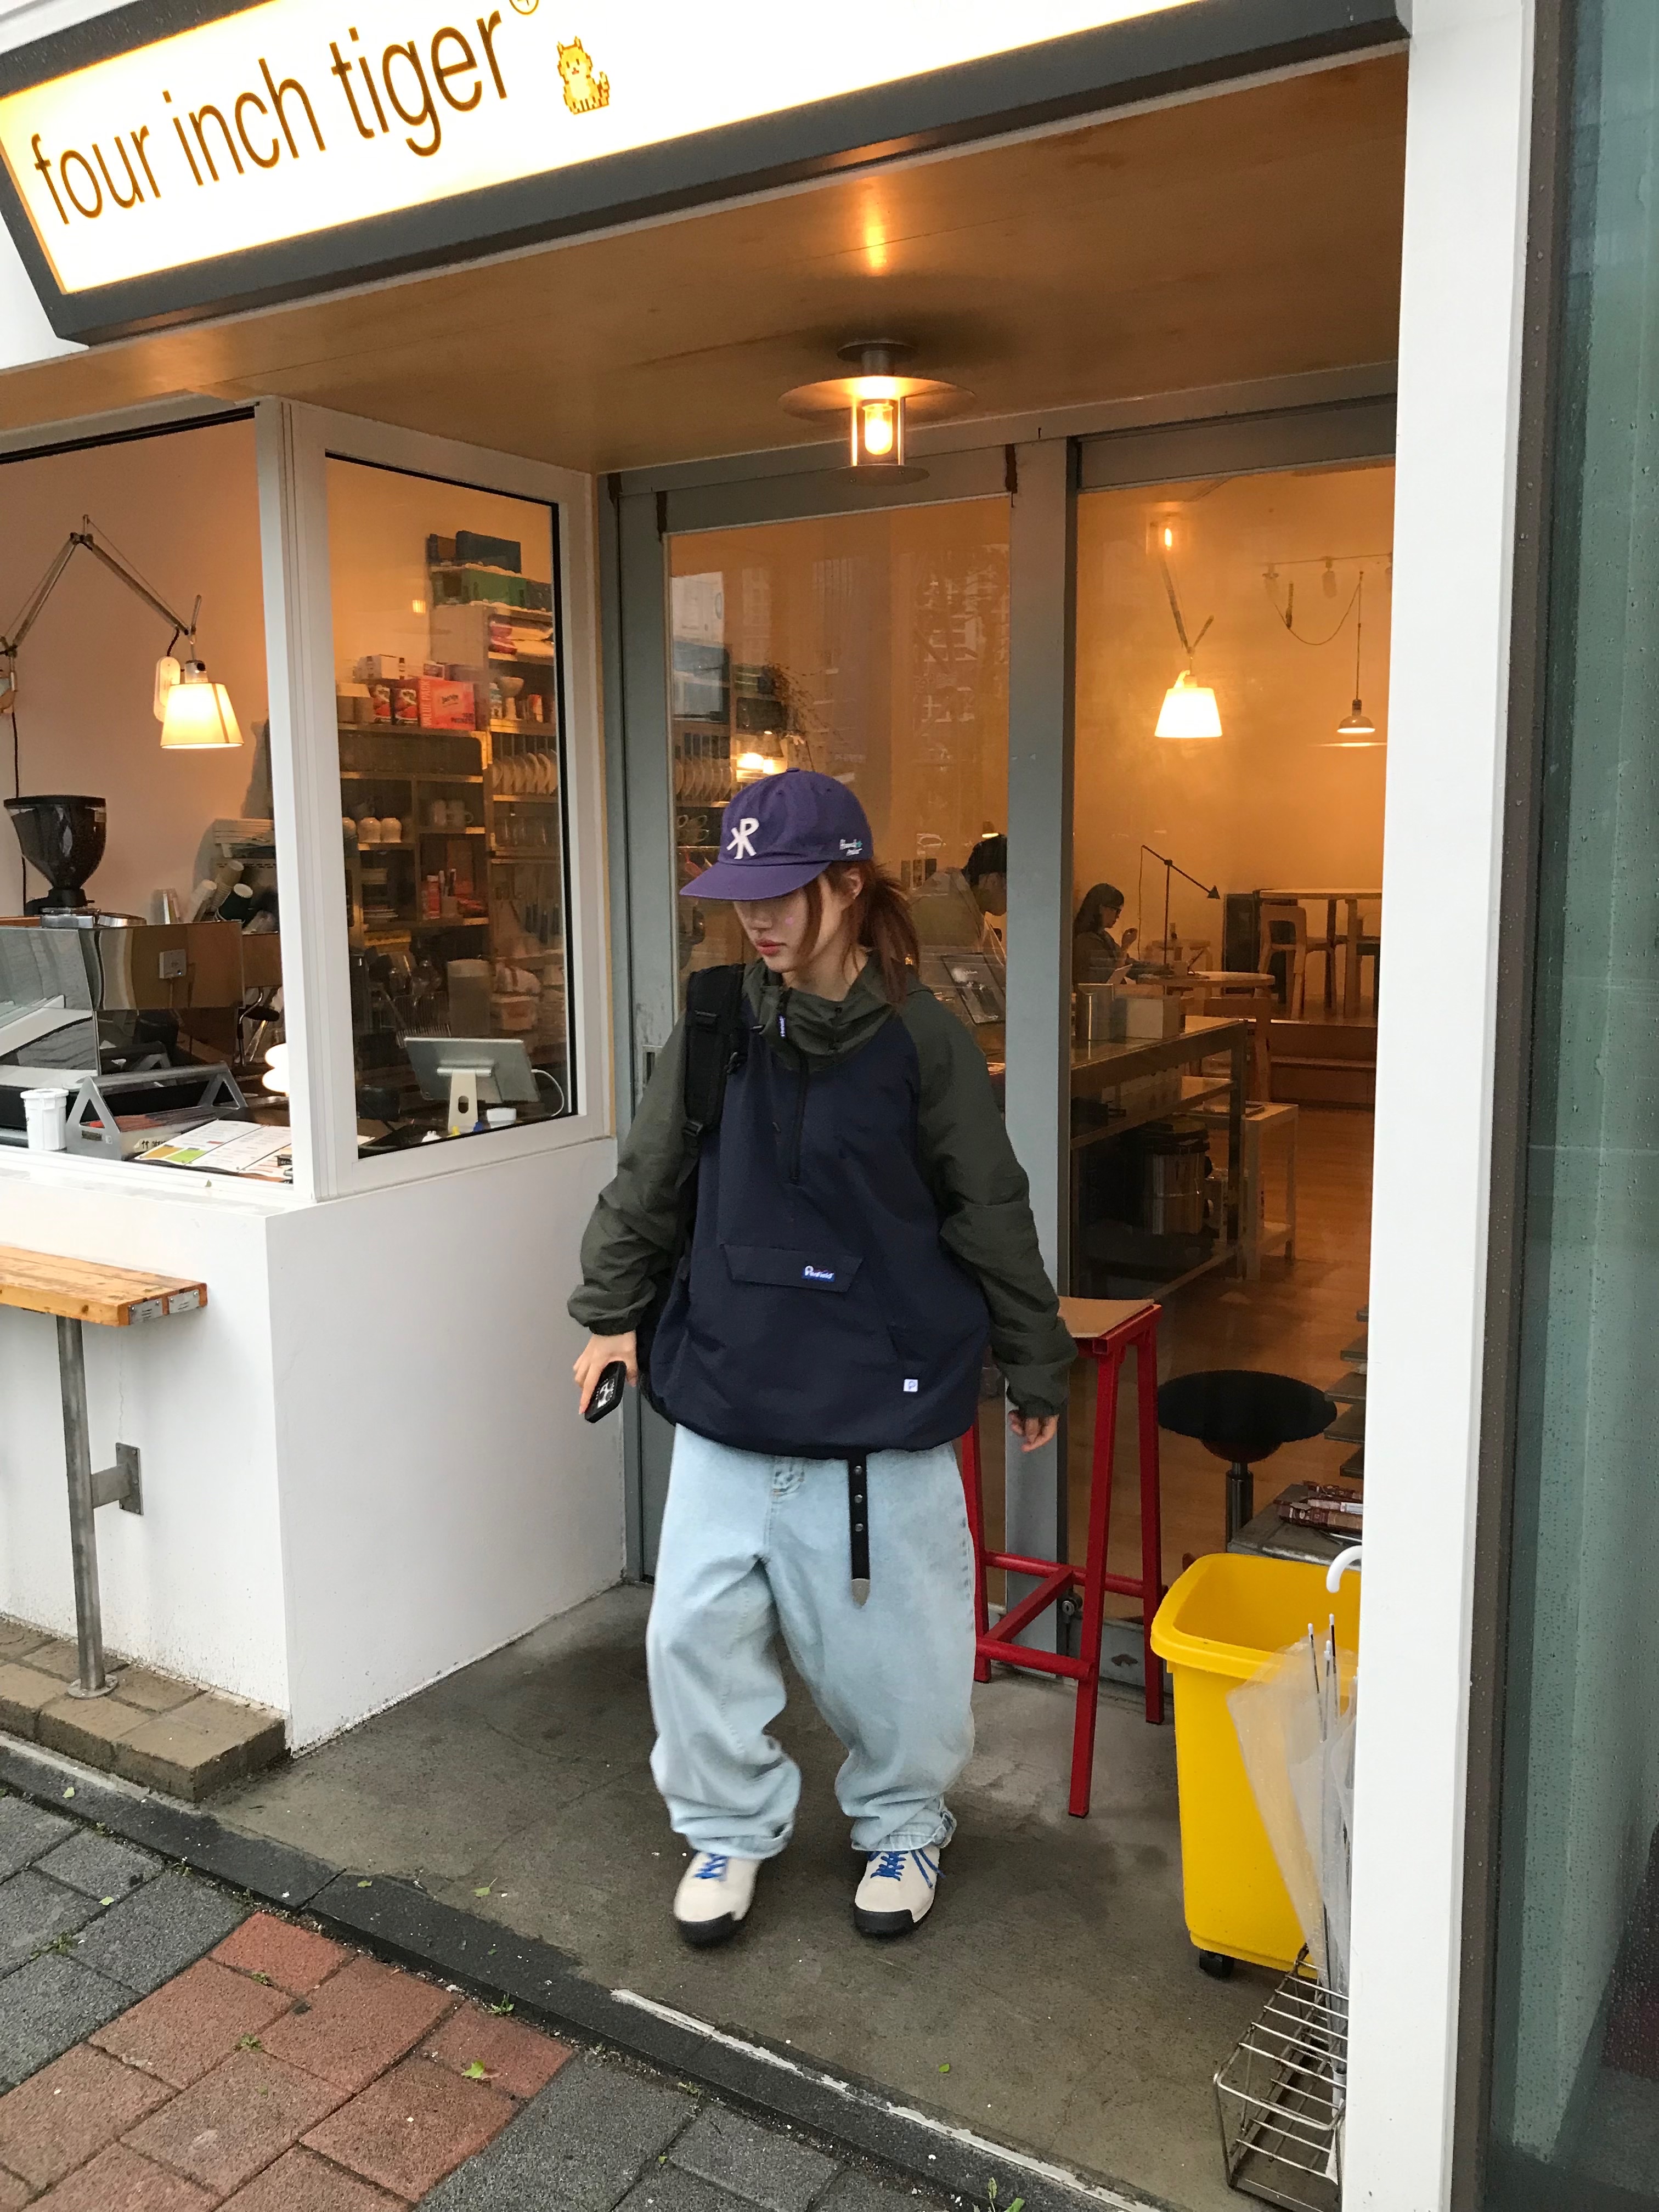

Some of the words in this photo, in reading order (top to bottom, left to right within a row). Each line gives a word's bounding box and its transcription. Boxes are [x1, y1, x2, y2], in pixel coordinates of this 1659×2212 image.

[32, 126, 161, 224] four
[163, 59, 325, 185] inch
[330, 11, 506, 156] tiger
[421, 680, 432, 701] PACK
